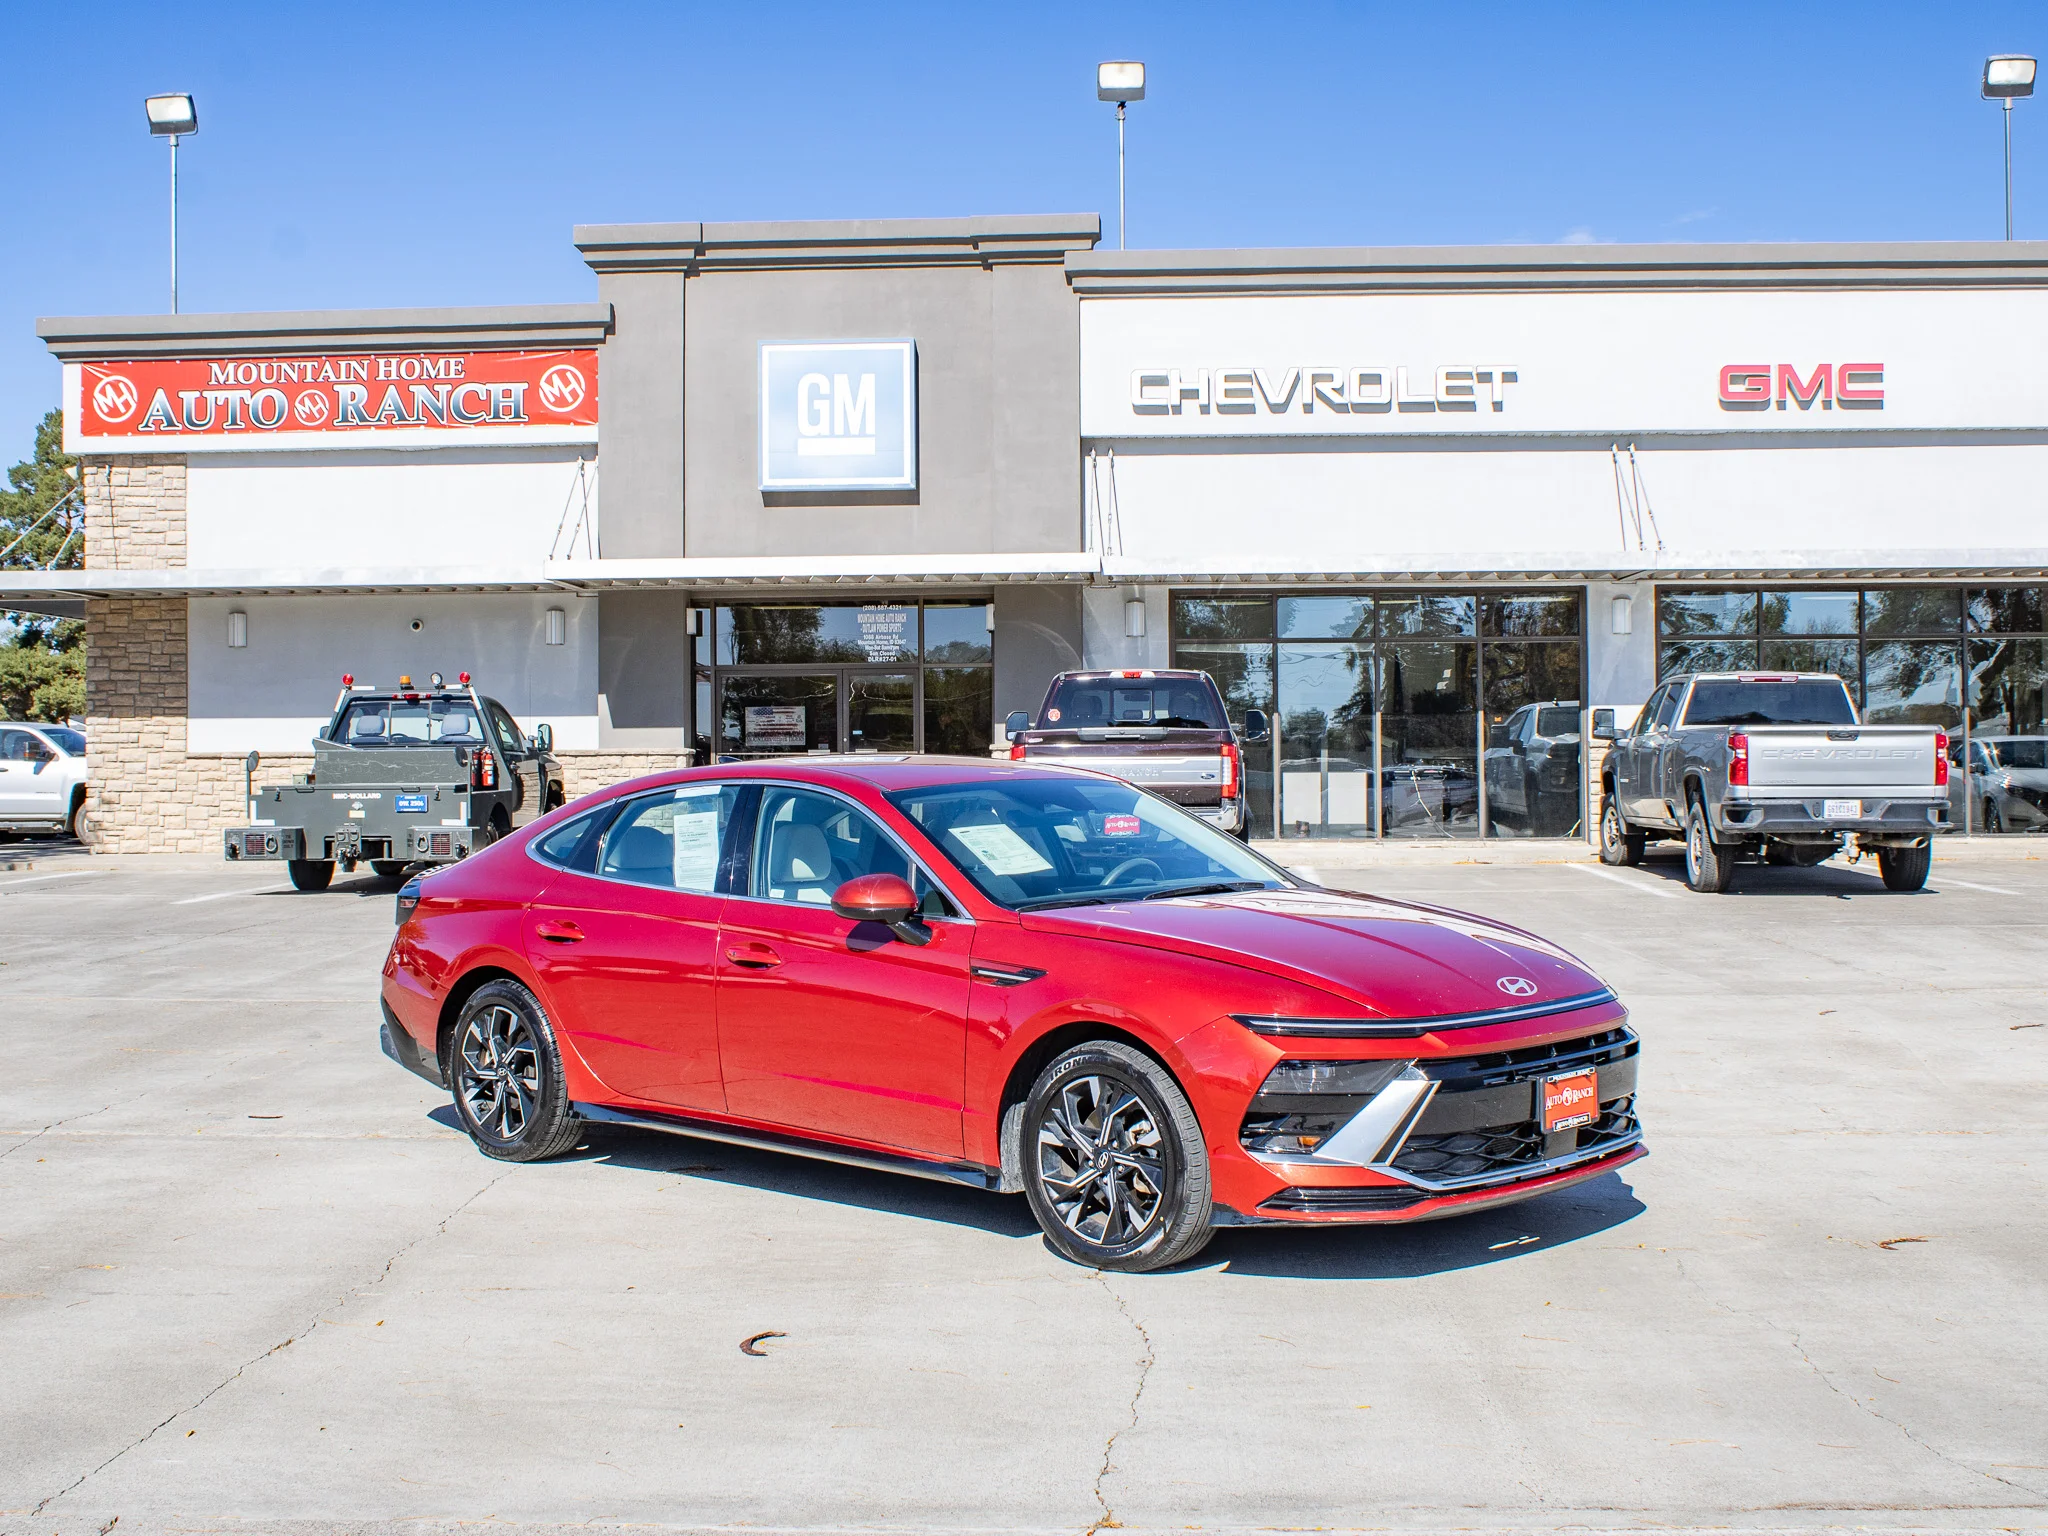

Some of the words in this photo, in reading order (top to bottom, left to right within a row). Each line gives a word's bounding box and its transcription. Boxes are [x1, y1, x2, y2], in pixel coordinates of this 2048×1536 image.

[208, 359, 370, 385] MOUNTAIN
[375, 357, 466, 381] HOME
[1131, 365, 1518, 414] CHEVROLET
[1719, 363, 1884, 410] GMC
[137, 387, 288, 431] AUTO
[333, 382, 529, 426] RANCH
[798, 373, 875, 436] GM
[1761, 749, 1925, 760] CHEVROLET
[1545, 1094, 1562, 1110] AUTO
[1572, 1087, 1594, 1103] RANCH
